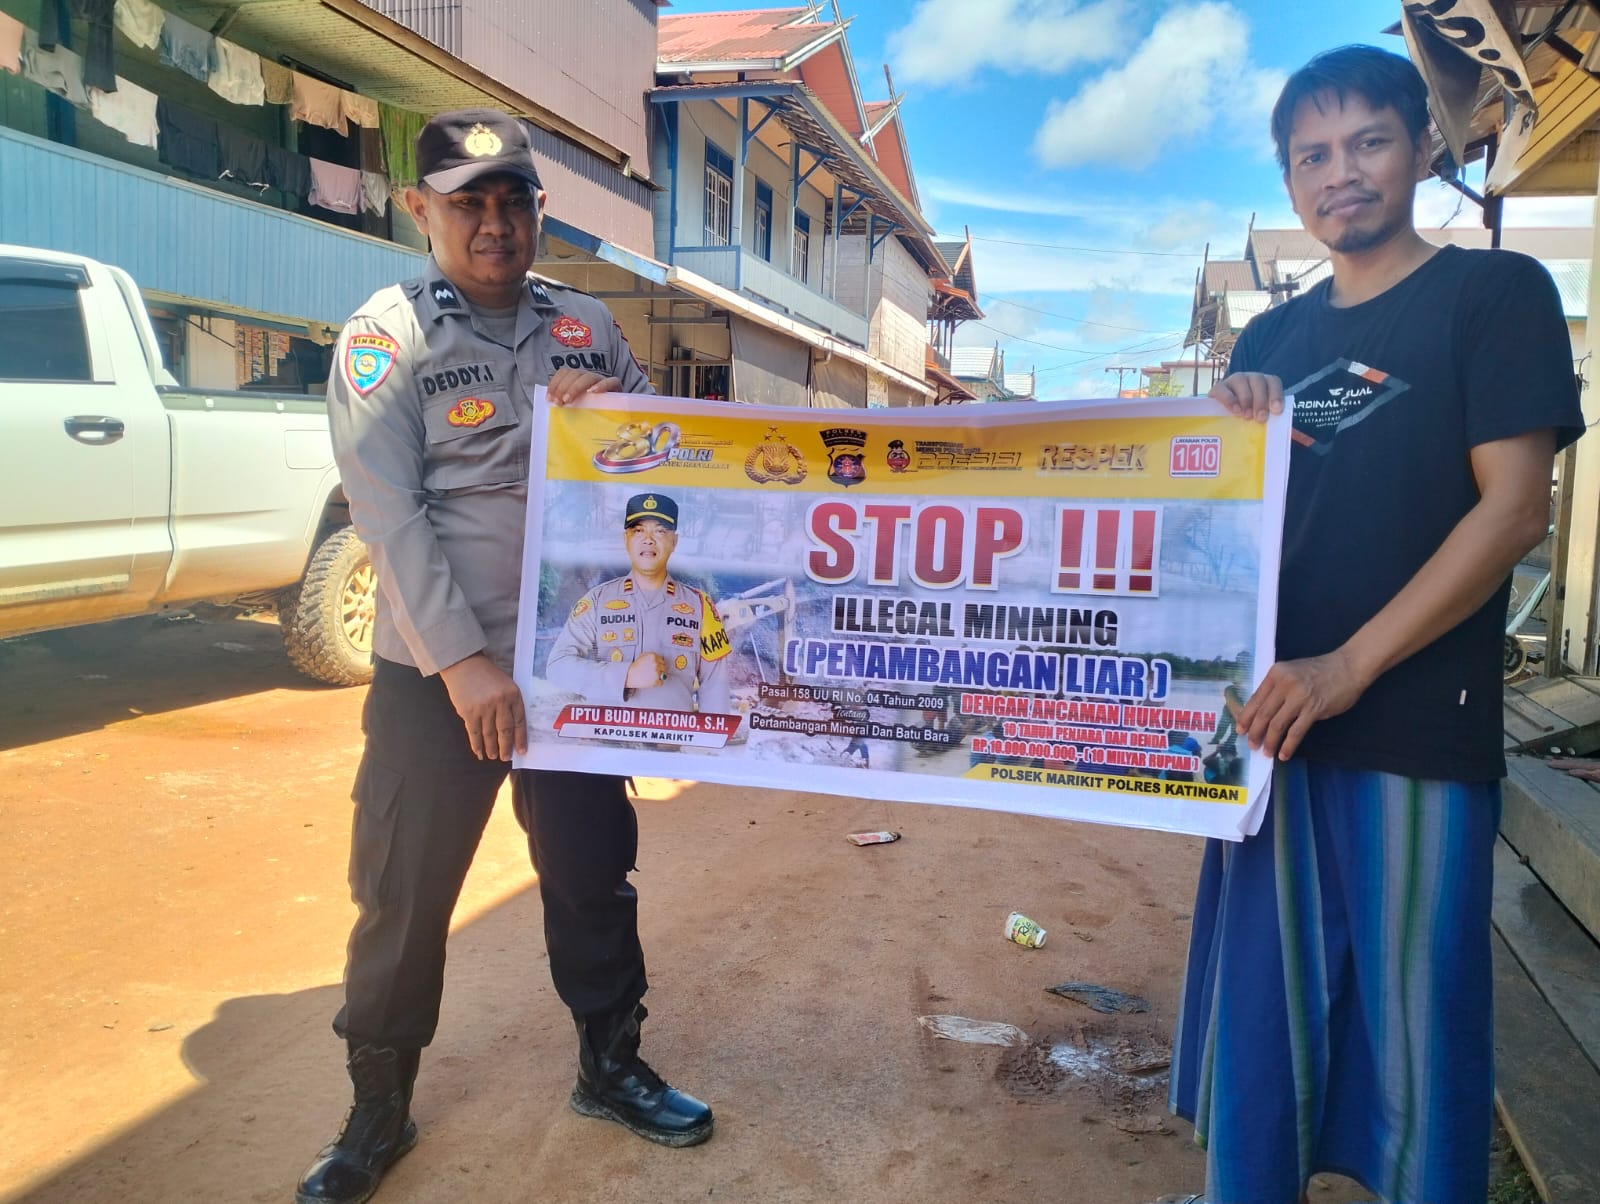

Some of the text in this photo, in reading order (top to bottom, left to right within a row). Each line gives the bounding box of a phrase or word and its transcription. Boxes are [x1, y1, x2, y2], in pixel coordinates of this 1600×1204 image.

[551, 353, 607, 370] POLRI
[423, 365, 494, 396] DEDDY.I
[668, 448, 714, 461] POLRI
[1040, 444, 1147, 470] RESPEK
[1174, 446, 1217, 469] 110
[808, 501, 1025, 588] STOP
[601, 614, 635, 625] BUDI.H
[667, 617, 699, 630] POLRI
[834, 596, 1119, 648] ILLEGAL MINNING
[761, 685, 943, 709] Pasal 158 UU RI No. 04 Tahun 2009
[570, 707, 729, 731] IPTU BUDI HARTONO, S.H.
[835, 706, 867, 721] Tentang
[961, 694, 1217, 733] DENGAN ANCAMAN HUKUMAN
[594, 728, 694, 742] KAPOLSEK MARIKIT
[752, 714, 950, 743] Pertambangan Mineral Dan Batu Bara
[1019, 724, 1053, 740] TAHUN
[1055, 726, 1103, 745] PENJARA
[1105, 731, 1128, 746] DAN
[1130, 732, 1168, 748] DENDA
[1107, 750, 1146, 767] MILYAR
[990, 767, 1240, 801] POLSEK MARIKIT POLRES KATINGAN
